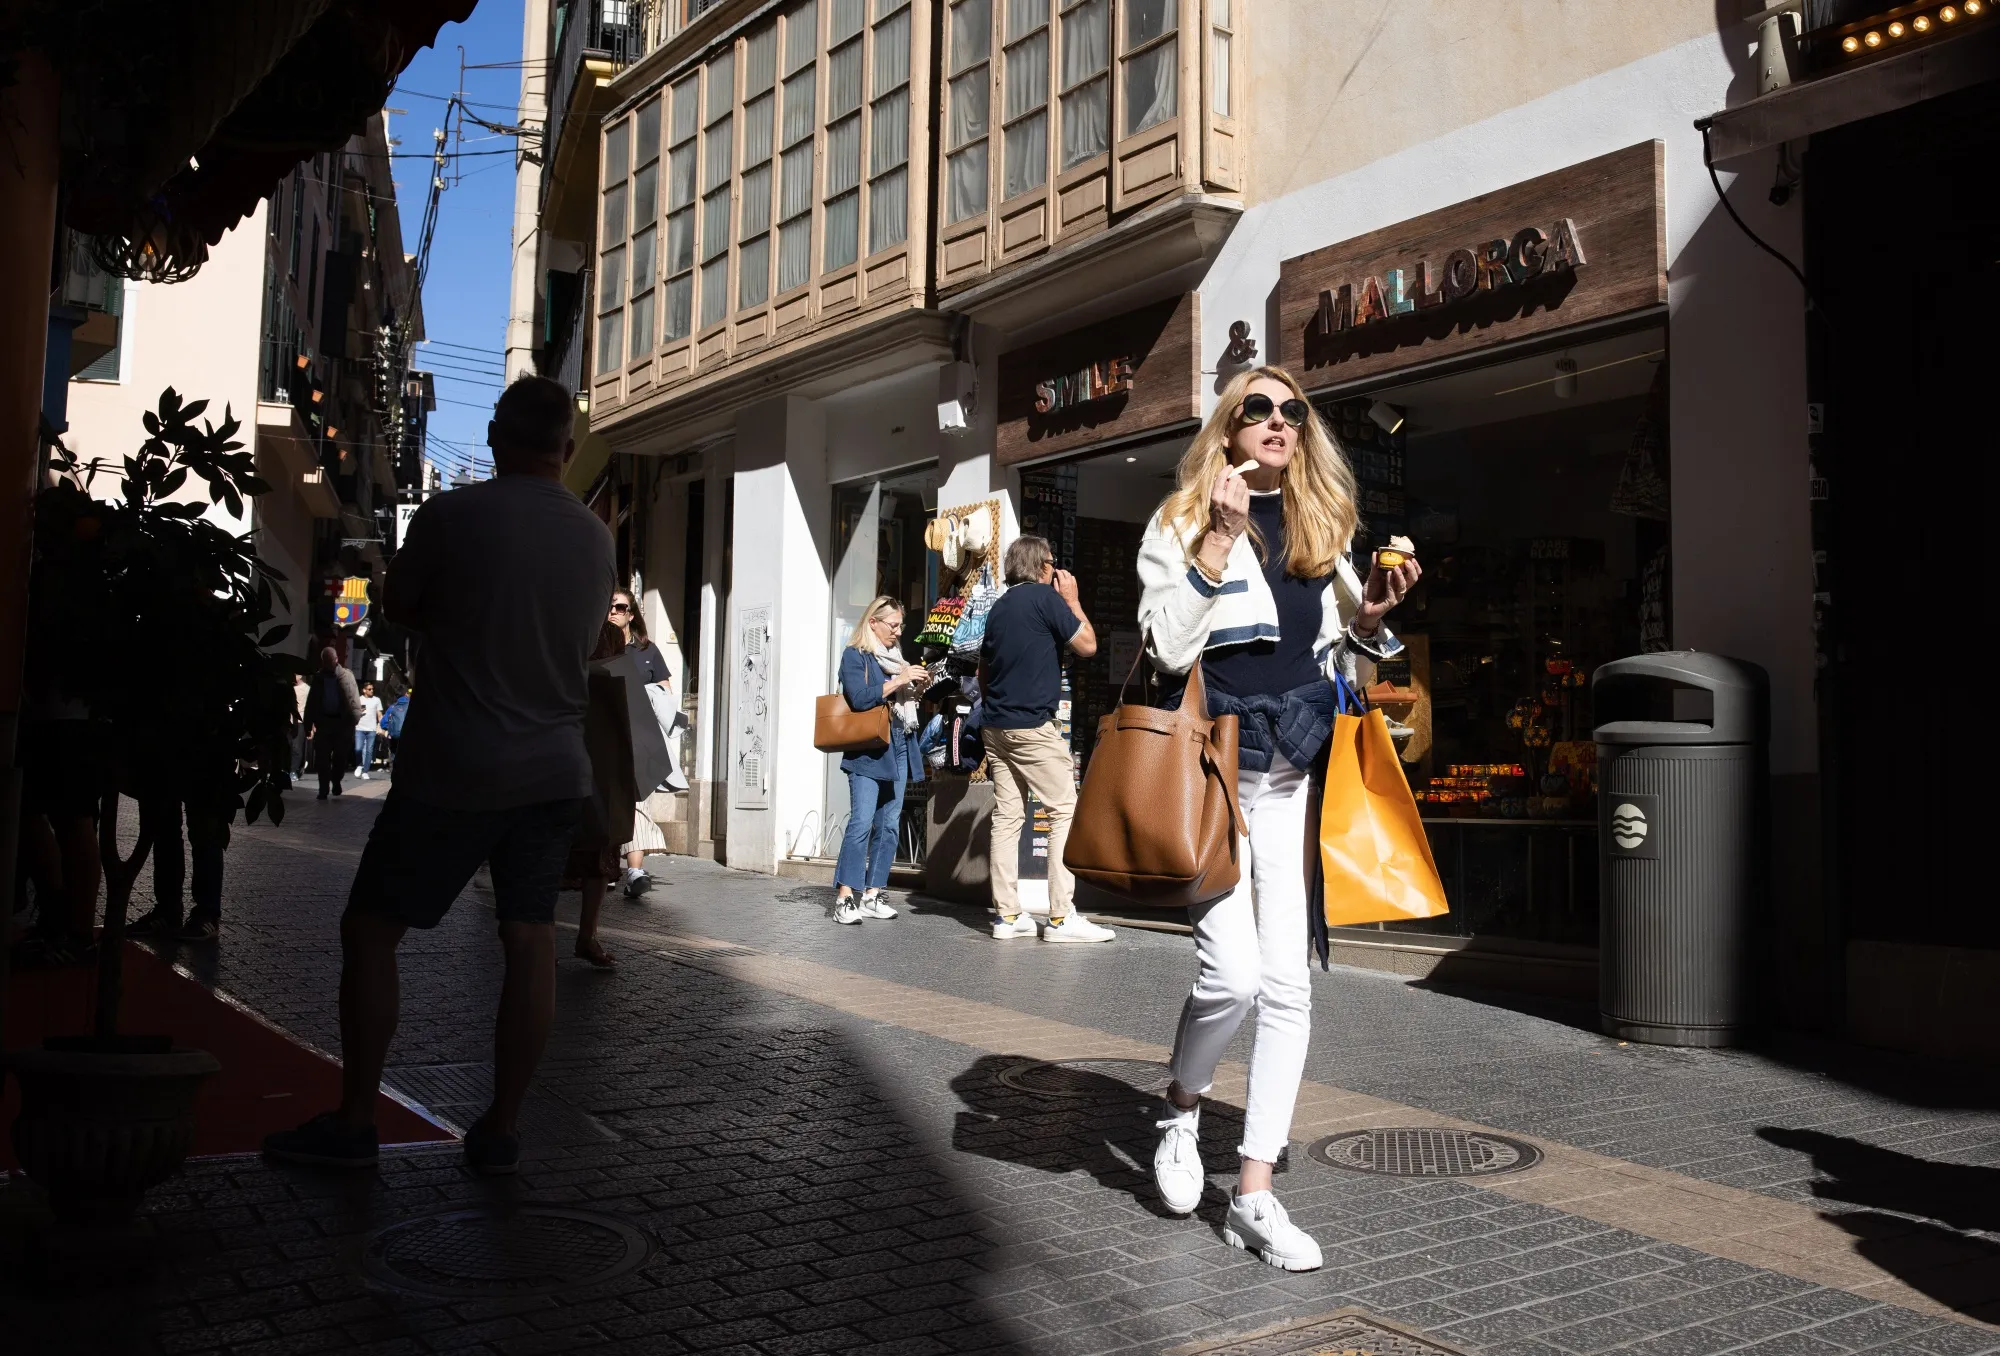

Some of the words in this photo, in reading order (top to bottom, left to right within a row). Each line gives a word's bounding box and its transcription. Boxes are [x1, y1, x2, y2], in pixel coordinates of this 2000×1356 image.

[1035, 355, 1133, 413] SMILE
[1229, 320, 1258, 364] &
[1319, 217, 1587, 335] MALLORCA
[1312, 1335, 1373, 1353] POTABLE
